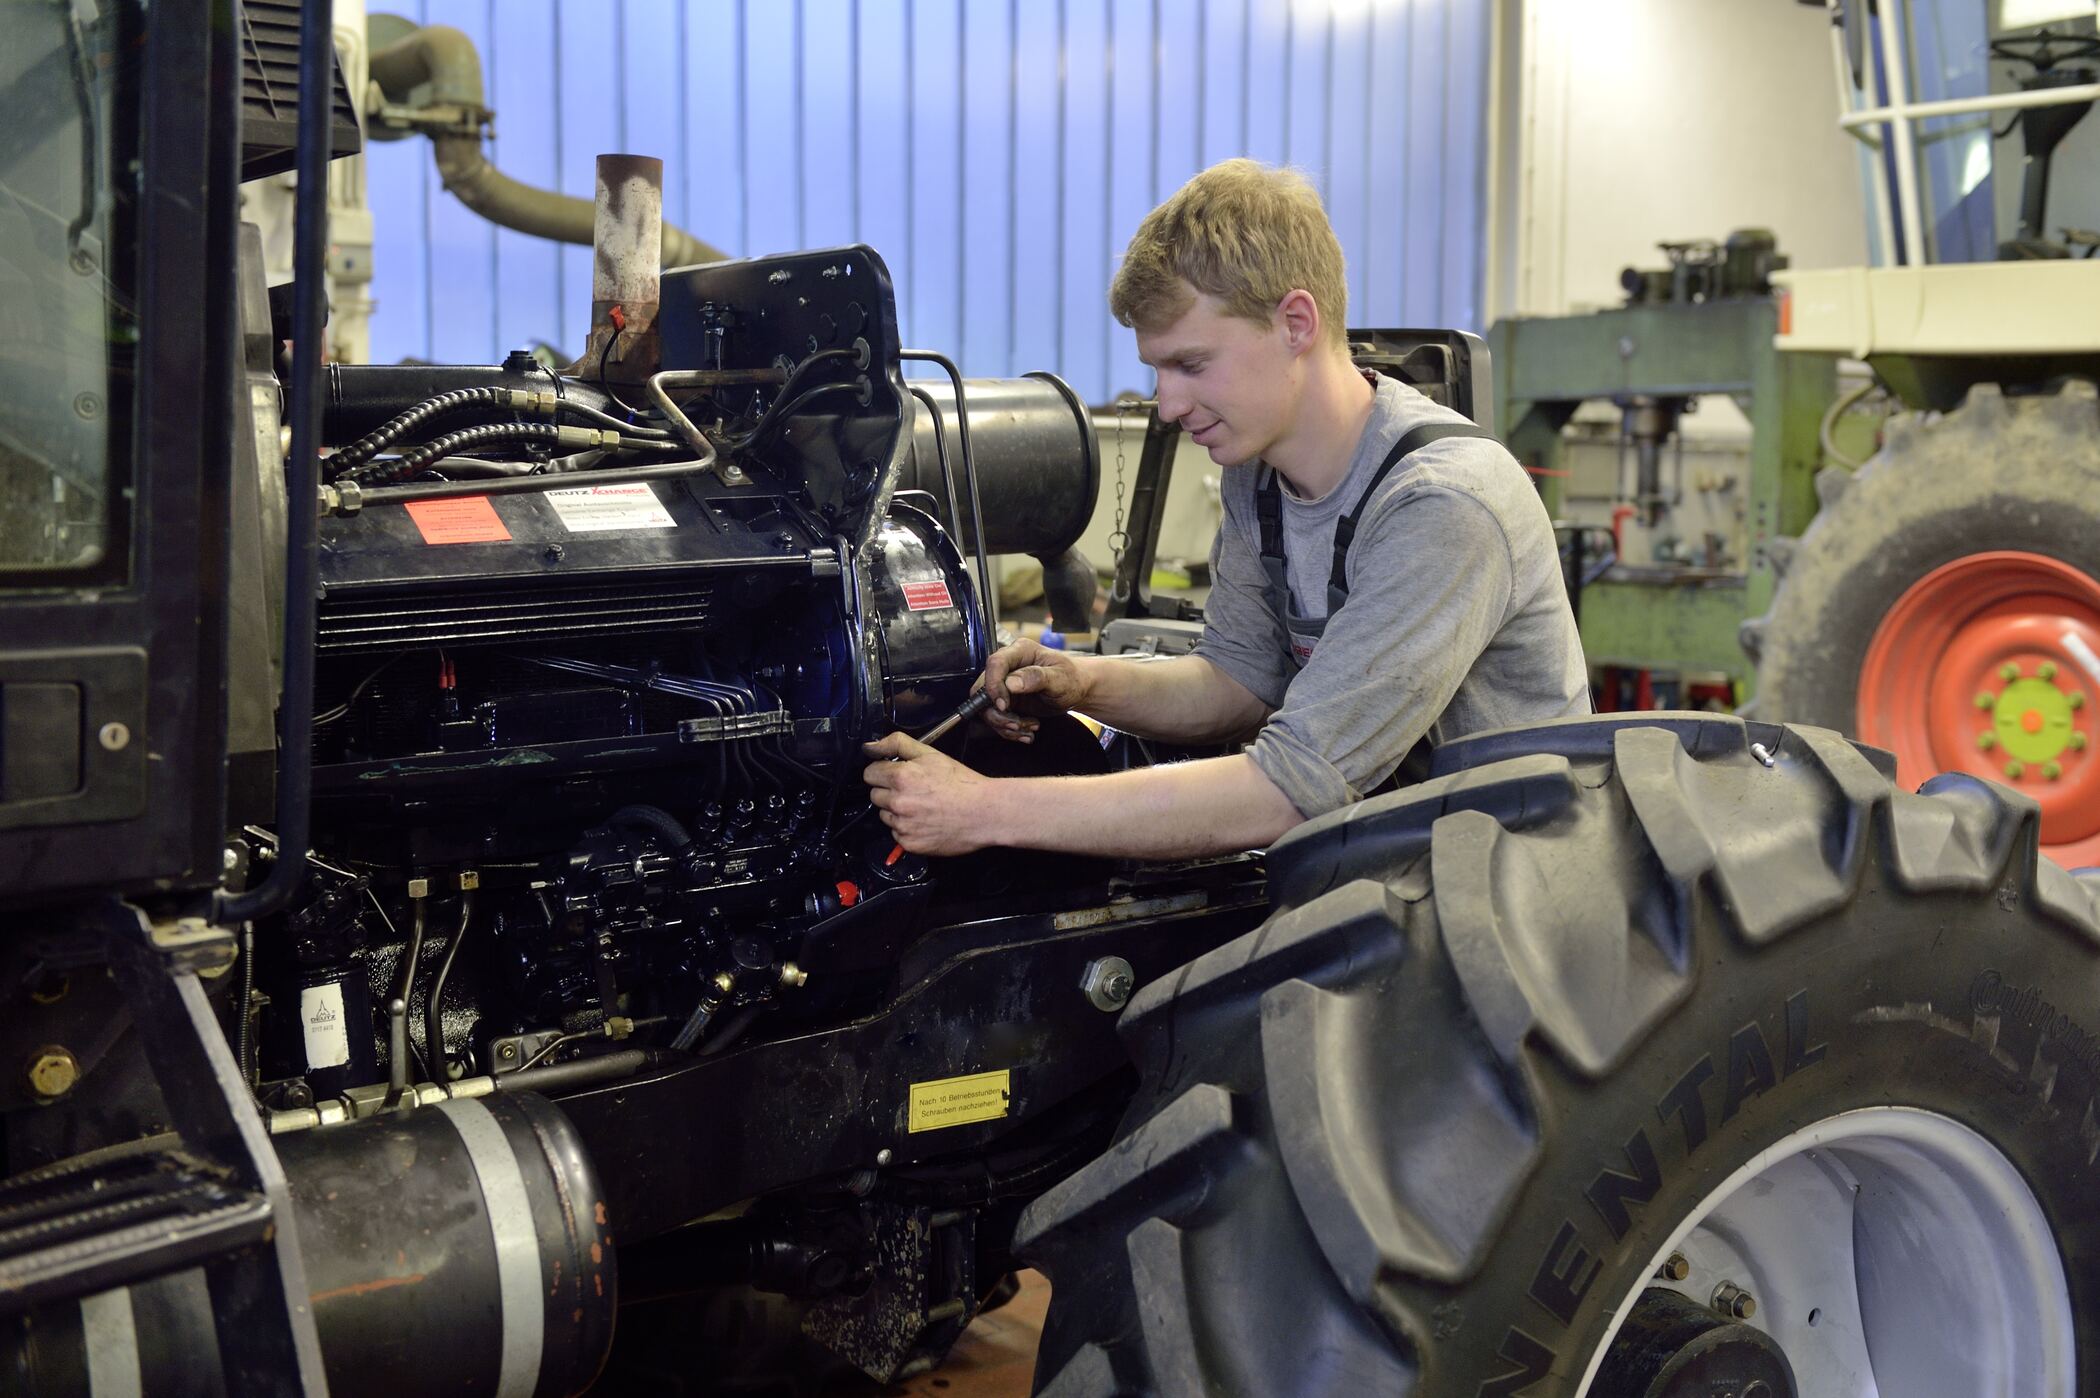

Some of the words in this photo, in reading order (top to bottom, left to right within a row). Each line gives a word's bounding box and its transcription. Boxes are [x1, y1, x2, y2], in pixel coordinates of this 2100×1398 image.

[311, 1014, 336, 1023] DEUTZ
[919, 1098, 937, 1106] Nach
[949, 1088, 1001, 1102] Betriebsstunden
[921, 1106, 957, 1118] Schrauben
[959, 1098, 998, 1111] nachziehen!
